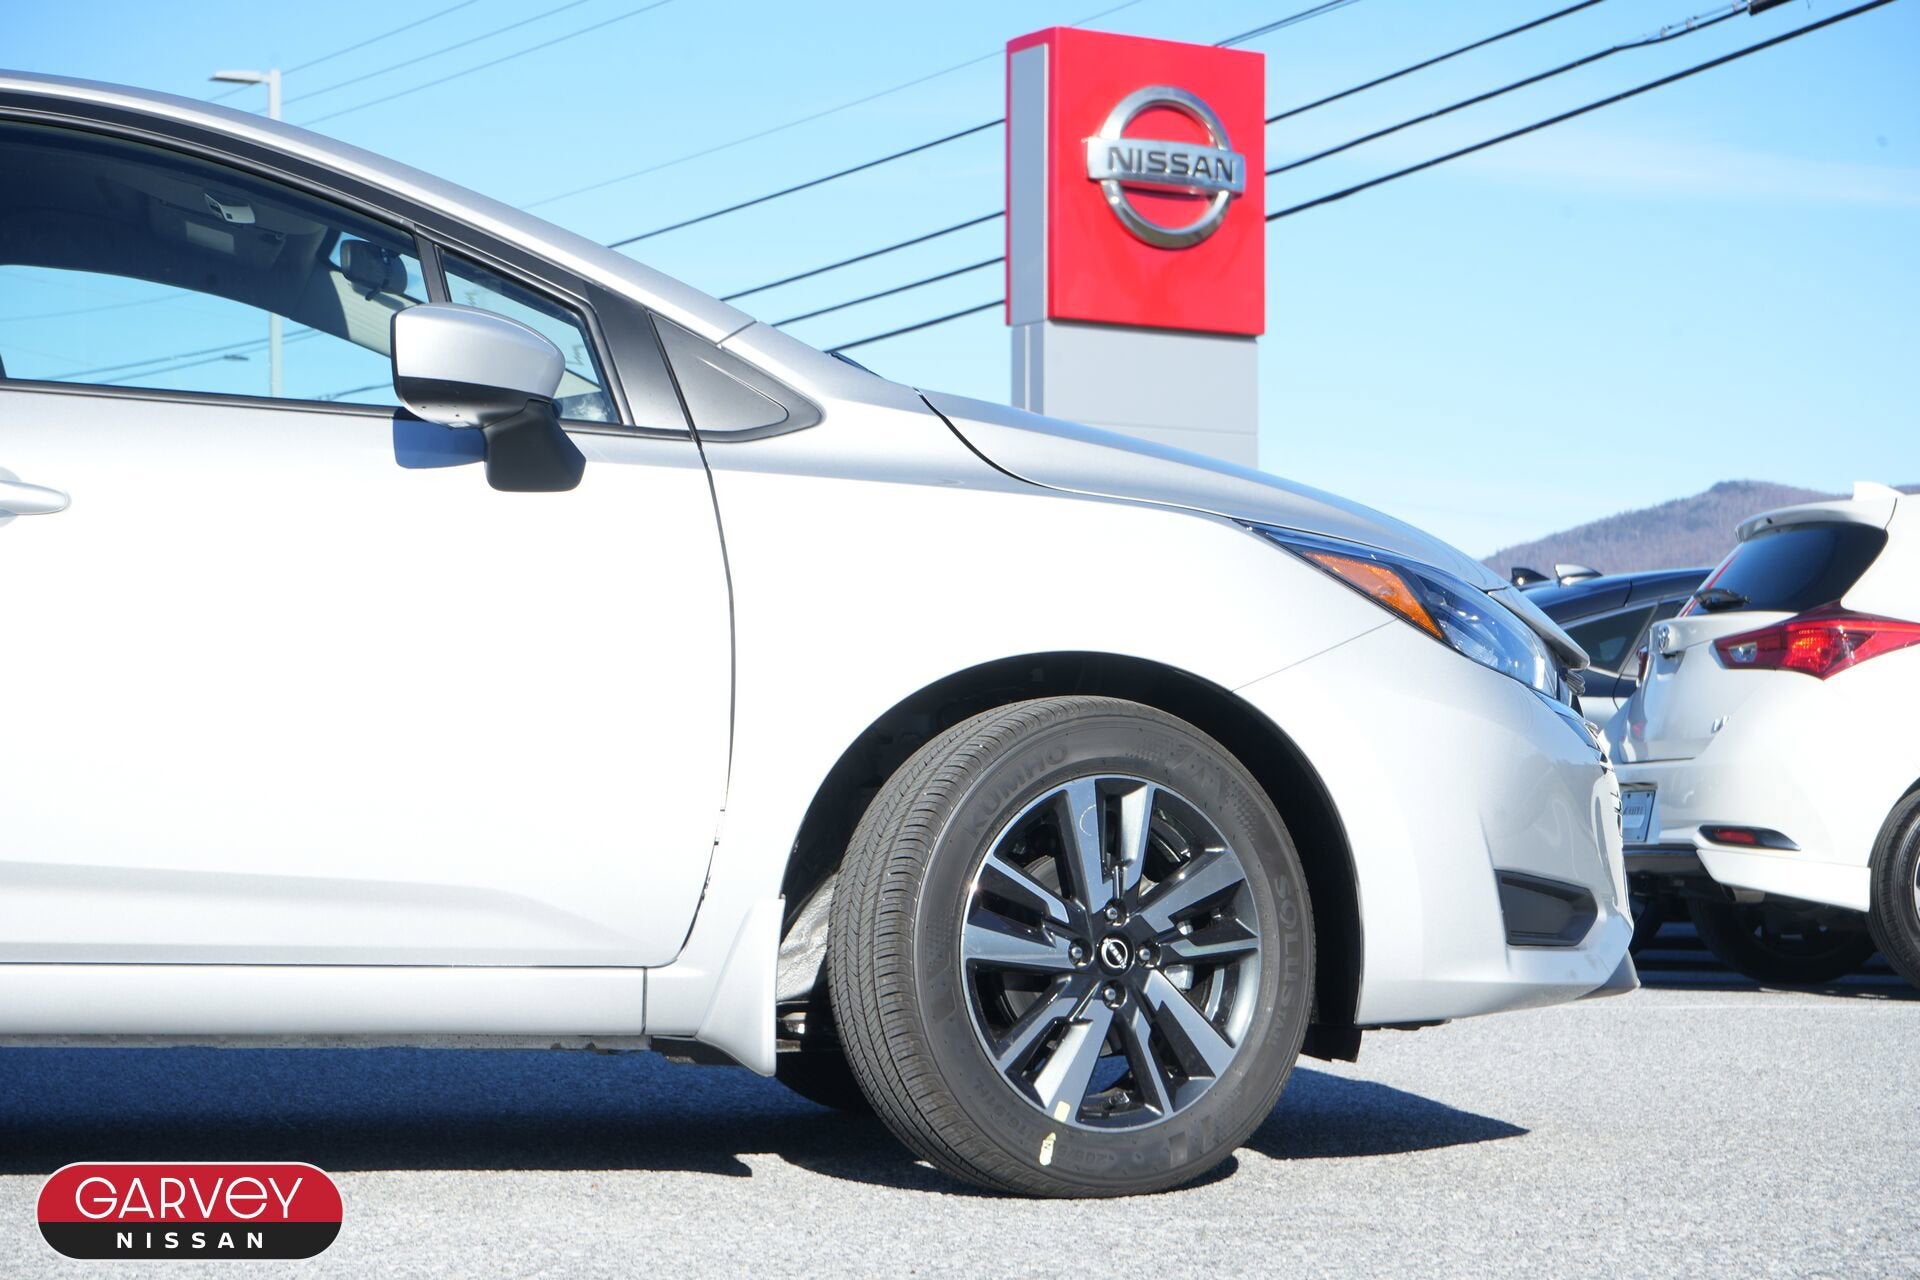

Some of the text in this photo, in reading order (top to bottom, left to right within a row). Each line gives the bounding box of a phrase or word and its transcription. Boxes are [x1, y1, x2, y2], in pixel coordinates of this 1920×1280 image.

[1107, 146, 1236, 184] NISSAN
[962, 743, 1069, 839] KUMHO
[1274, 874, 1300, 1007] SOLUS
